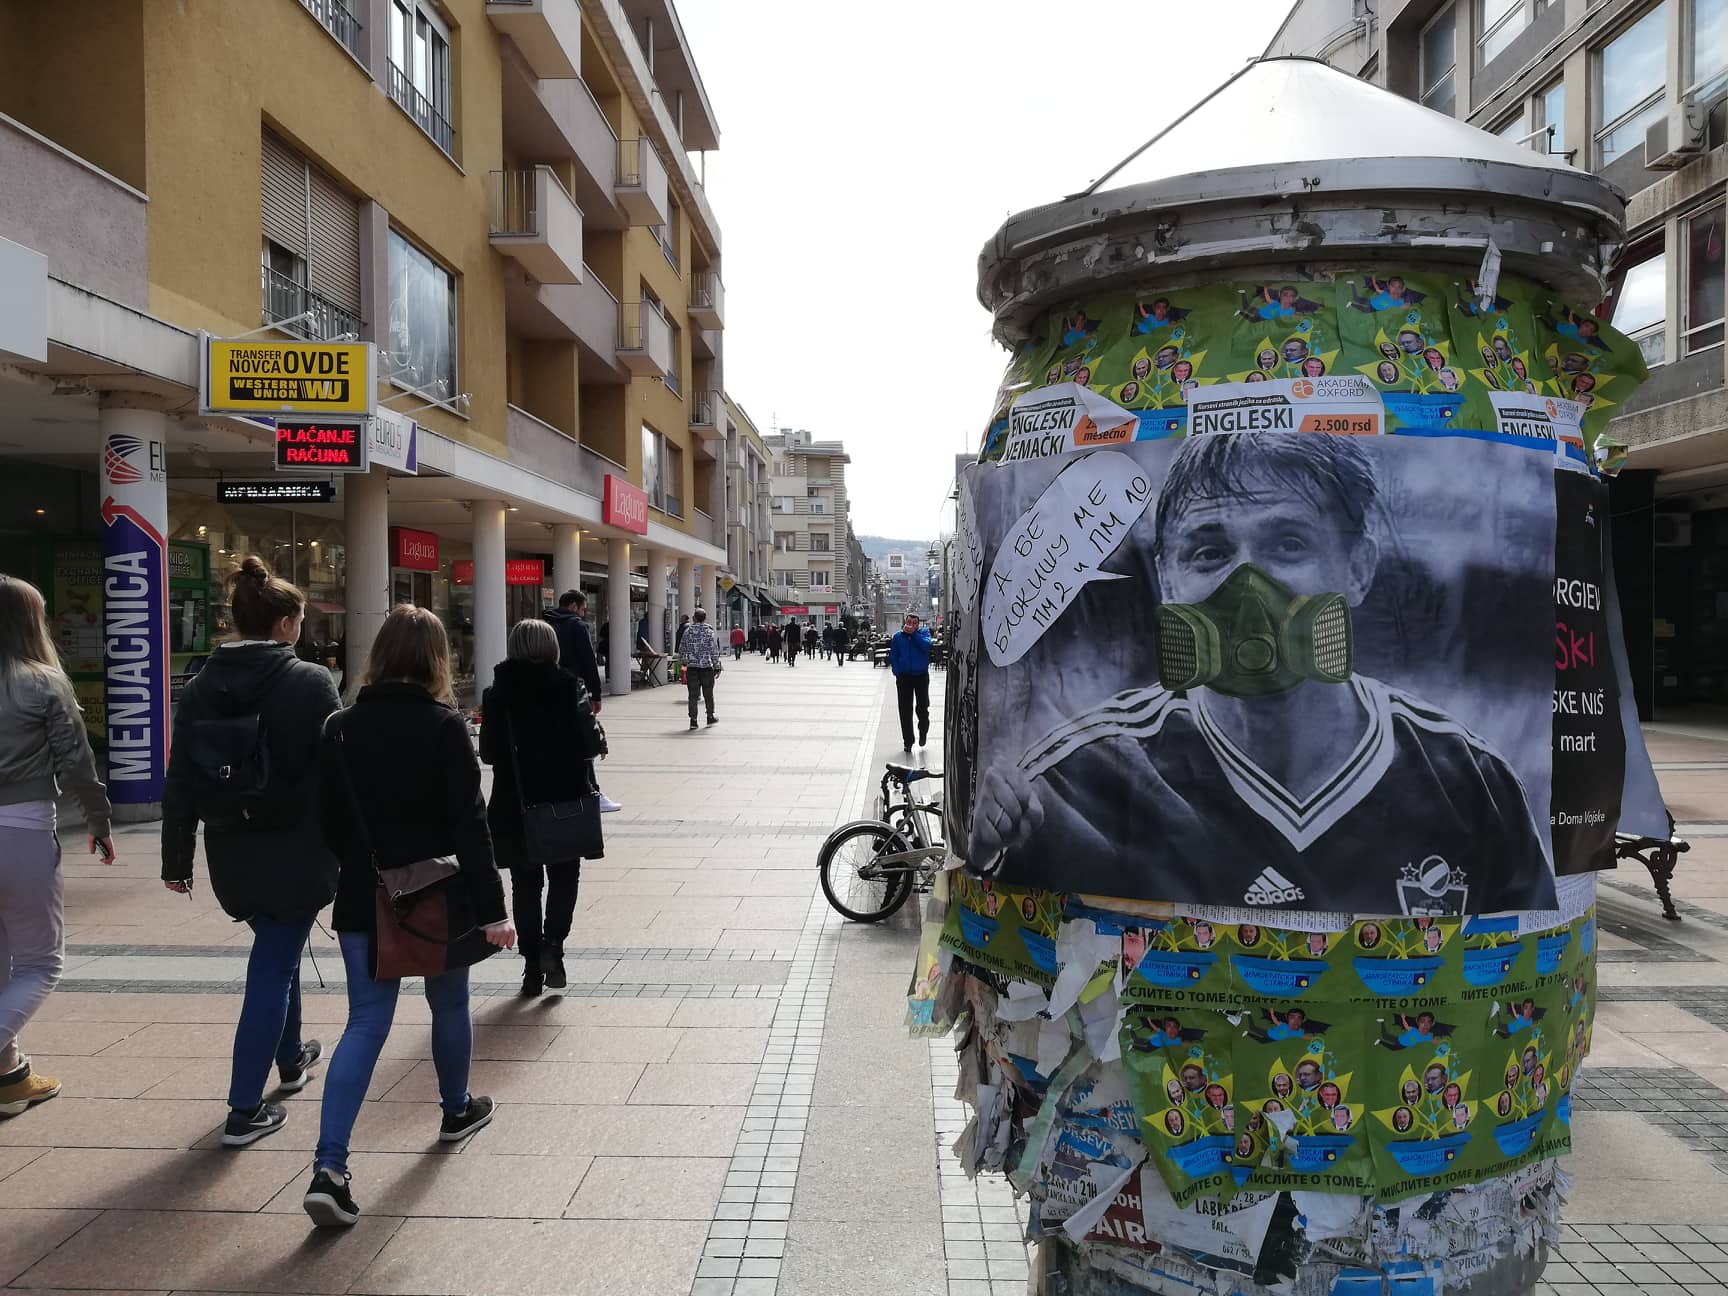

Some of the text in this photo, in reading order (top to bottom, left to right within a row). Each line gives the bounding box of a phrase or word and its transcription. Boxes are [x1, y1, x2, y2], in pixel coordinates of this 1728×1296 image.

[230, 349, 281, 359] TRANSFER
[229, 359, 281, 373] NOVCA
[283, 350, 349, 375] OVDE
[233, 379, 298, 389] WESTERN
[253, 389, 298, 399] UNION
[1317, 388, 1365, 397] OXFORD
[1012, 409, 1076, 437] ENGLESKI
[1192, 408, 1294, 434] ENGLESKI
[1313, 419, 1371, 431] 2.500 rsd
[286, 444, 349, 463] RAČUNA
[614, 484, 644, 524] Laguna
[403, 537, 436, 561] Laguna
[103, 550, 152, 781] MENJAČNICA
[1581, 688, 1605, 716] NIŠ
[1560, 731, 1597, 752] mart
[1558, 811, 1583, 826] Doma
[1584, 808, 1605, 827] Vojske
[1243, 887, 1305, 905] adidas
[1175, 990, 1185, 1001] О
[1490, 987, 1498, 997] О
[1399, 998, 1409, 1008] О
[1212, 1175, 1223, 1186] О
[1310, 1174, 1321, 1185] О
[1432, 1176, 1442, 1186] О
